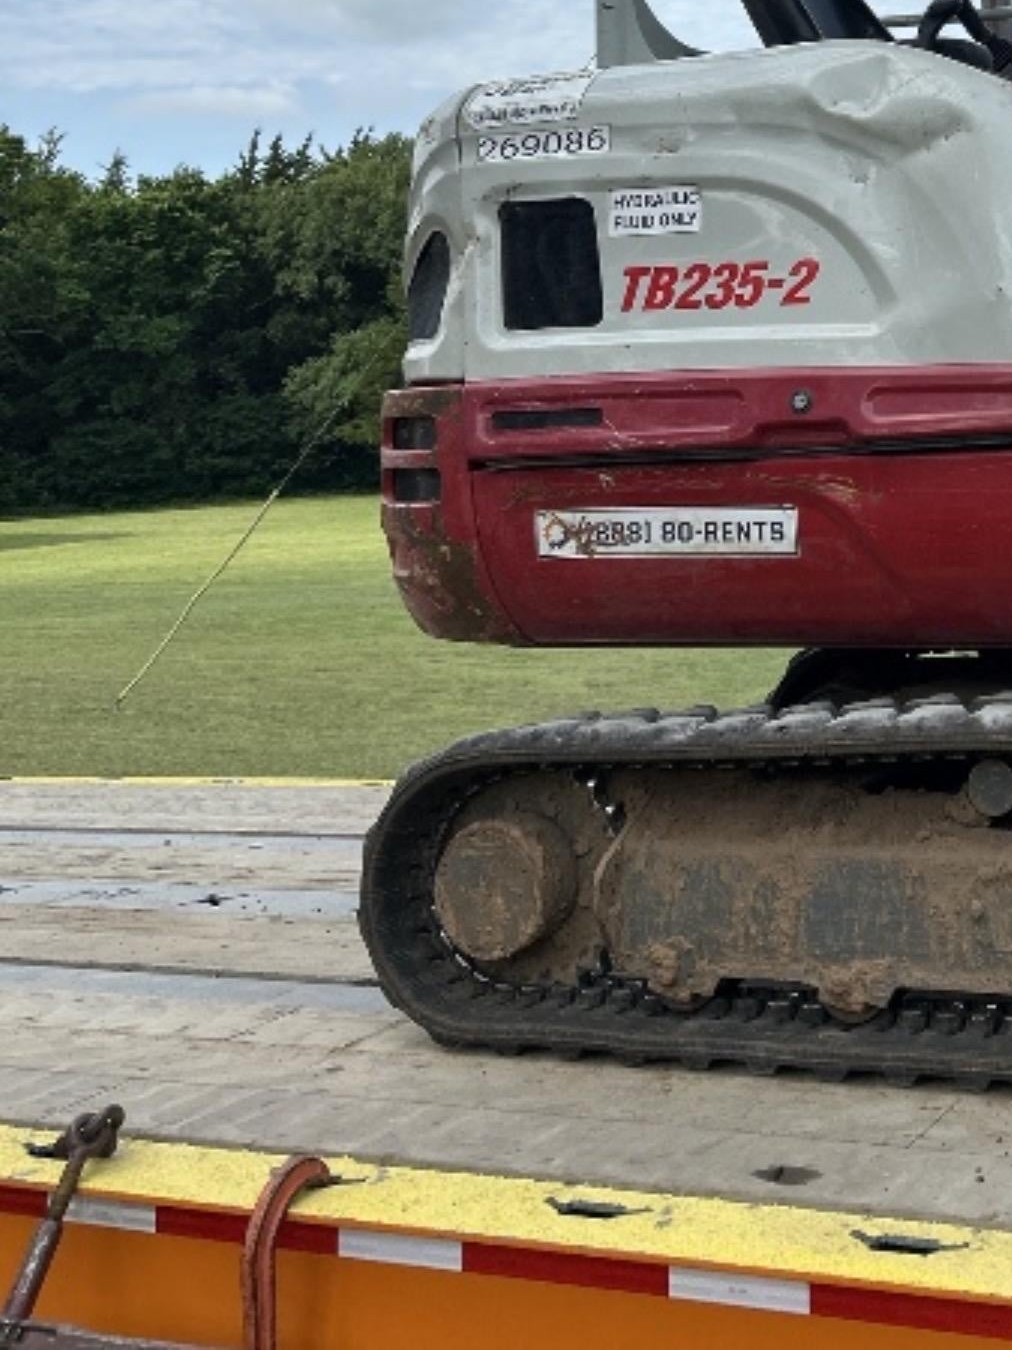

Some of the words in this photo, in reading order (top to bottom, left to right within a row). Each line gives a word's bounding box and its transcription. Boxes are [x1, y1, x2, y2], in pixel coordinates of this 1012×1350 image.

[478, 127, 607, 160] 269086
[613, 190, 701, 209] HYDRAULIC
[613, 215, 655, 230] FLUID
[659, 211, 697, 227] ONLY
[620, 256, 820, 313] TB235-2
[661, 520, 785, 543] 80-RENTS
